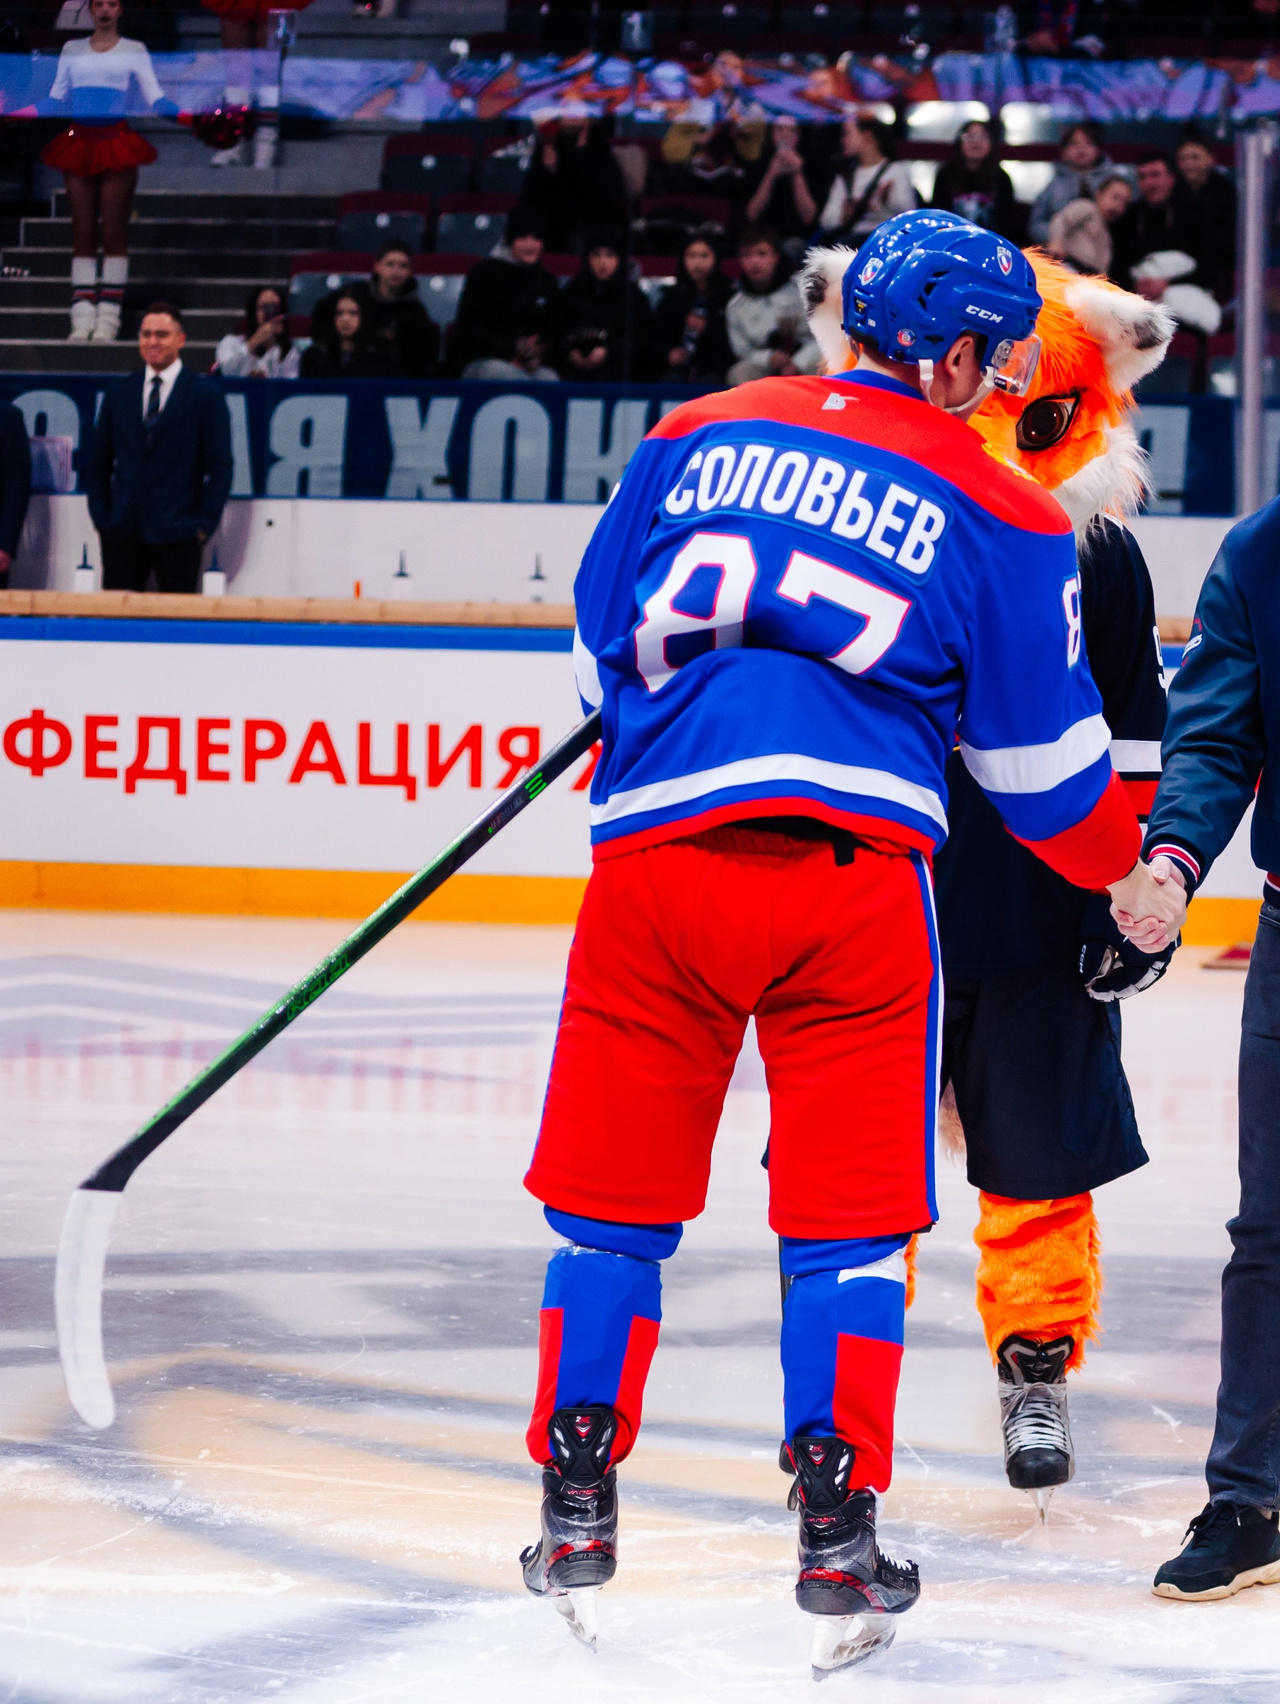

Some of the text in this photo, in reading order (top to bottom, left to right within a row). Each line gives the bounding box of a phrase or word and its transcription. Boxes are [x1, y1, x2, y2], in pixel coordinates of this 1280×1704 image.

[965, 304, 1004, 323] CCM
[663, 443, 948, 576] СОЛОВЬЕВ
[633, 531, 914, 696] 87
[2, 708, 542, 802] ФЕДЕРАЦИЯ
